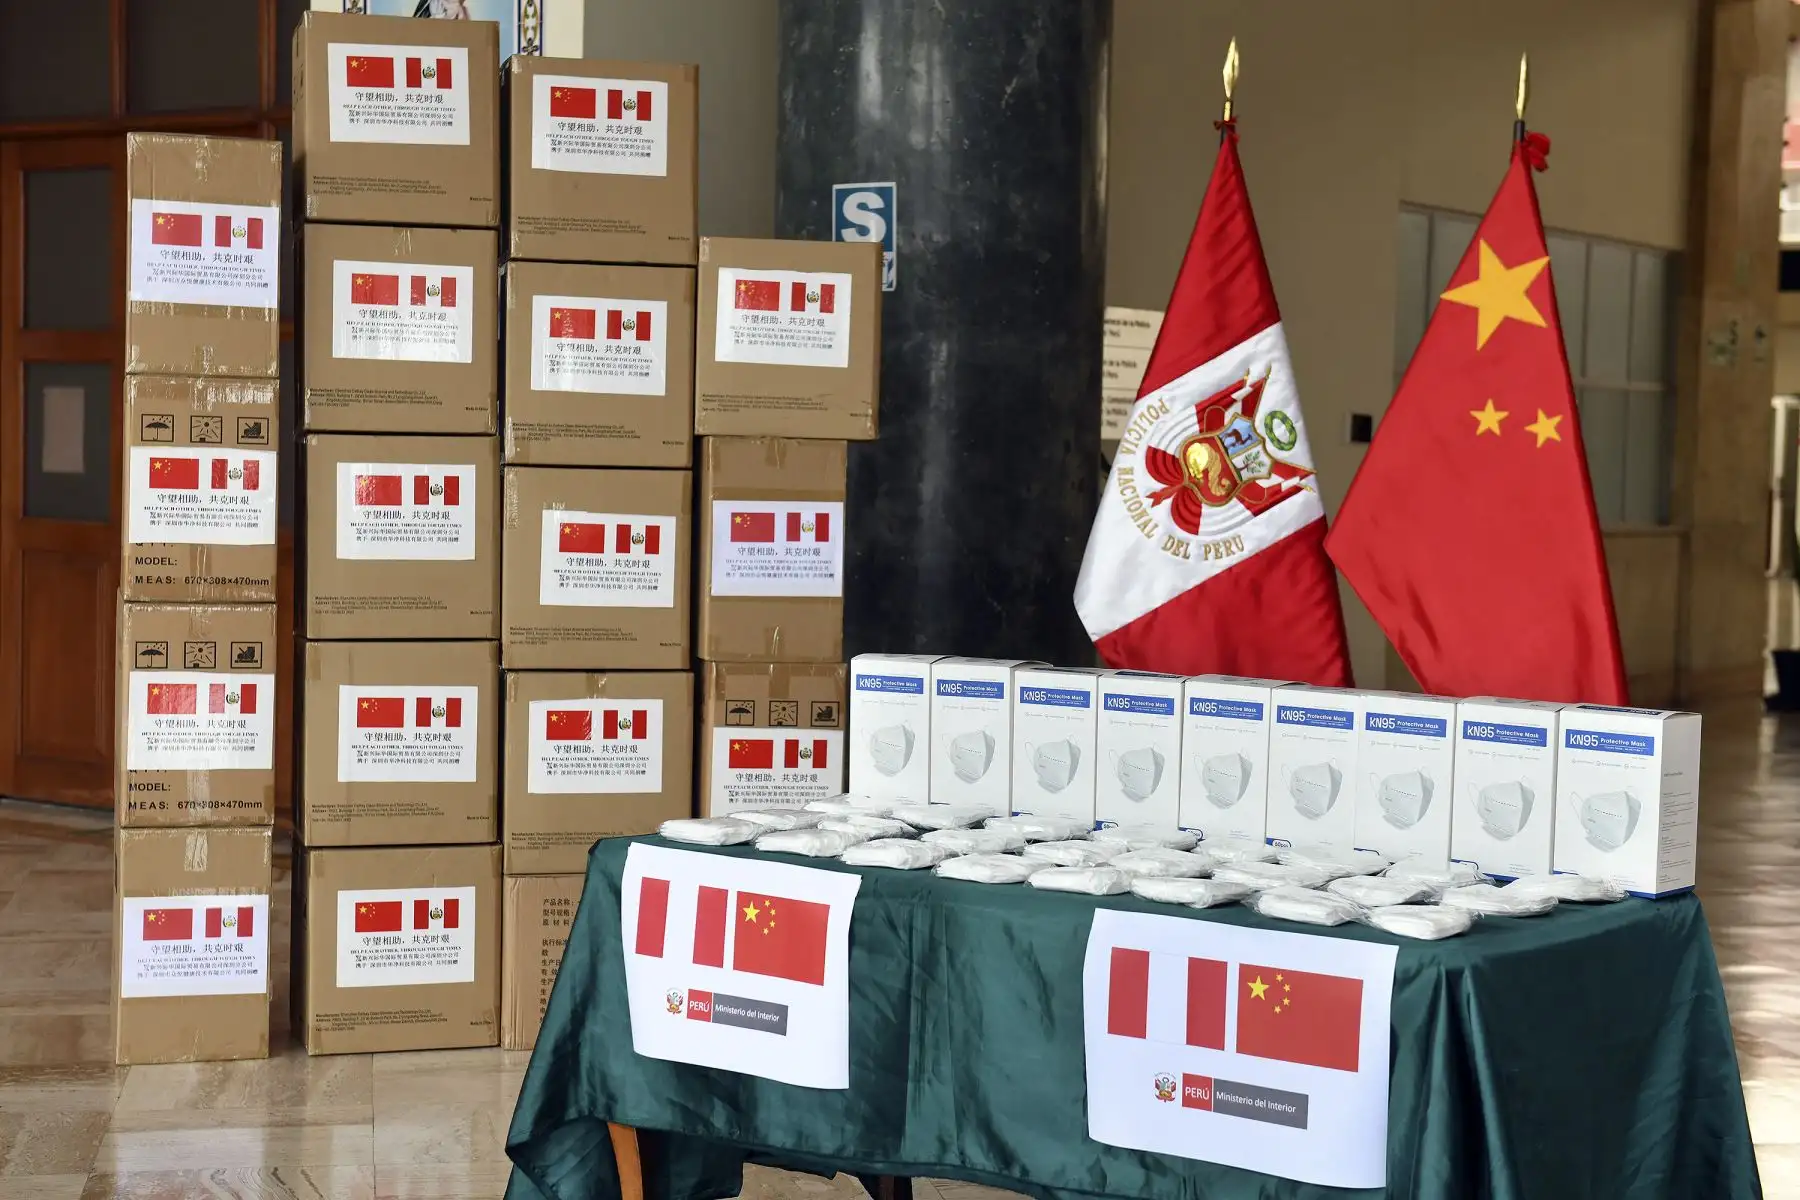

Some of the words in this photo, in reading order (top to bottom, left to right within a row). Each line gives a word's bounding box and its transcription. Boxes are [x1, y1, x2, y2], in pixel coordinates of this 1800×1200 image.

[841, 192, 886, 242] S
[1120, 398, 1170, 456] POLICIA
[1117, 466, 1159, 539] NACIONAL
[1161, 535, 1191, 560] DEL
[1204, 535, 1244, 561] PERU
[135, 557, 178, 566] MODEL:
[859, 678, 882, 688] KN95
[940, 683, 962, 694] KN95
[1023, 691, 1046, 701] KN95
[1107, 697, 1130, 709] KN95
[1193, 702, 1217, 714] KN95
[1280, 710, 1306, 722] KN95
[1369, 717, 1395, 729] KN95
[1397, 720, 1424, 728] Protective
[1467, 725, 1494, 738] KN95
[1496, 729, 1524, 737] Protective
[1569, 734, 1599, 747] KN95
[1600, 738, 1629, 746] Protective
[129, 783, 171, 791] MODEL:
[690, 1001, 710, 1012] PERÚ
[715, 1004, 745, 1016] Ministerio
[747, 1009, 756, 1018] del
[757, 1012, 779, 1022] Interior
[1185, 1086, 1209, 1100] PERÚ
[1216, 1091, 1253, 1105] Ministerio
[1254, 1099, 1266, 1108] del
[1268, 1101, 1296, 1113] Interior
